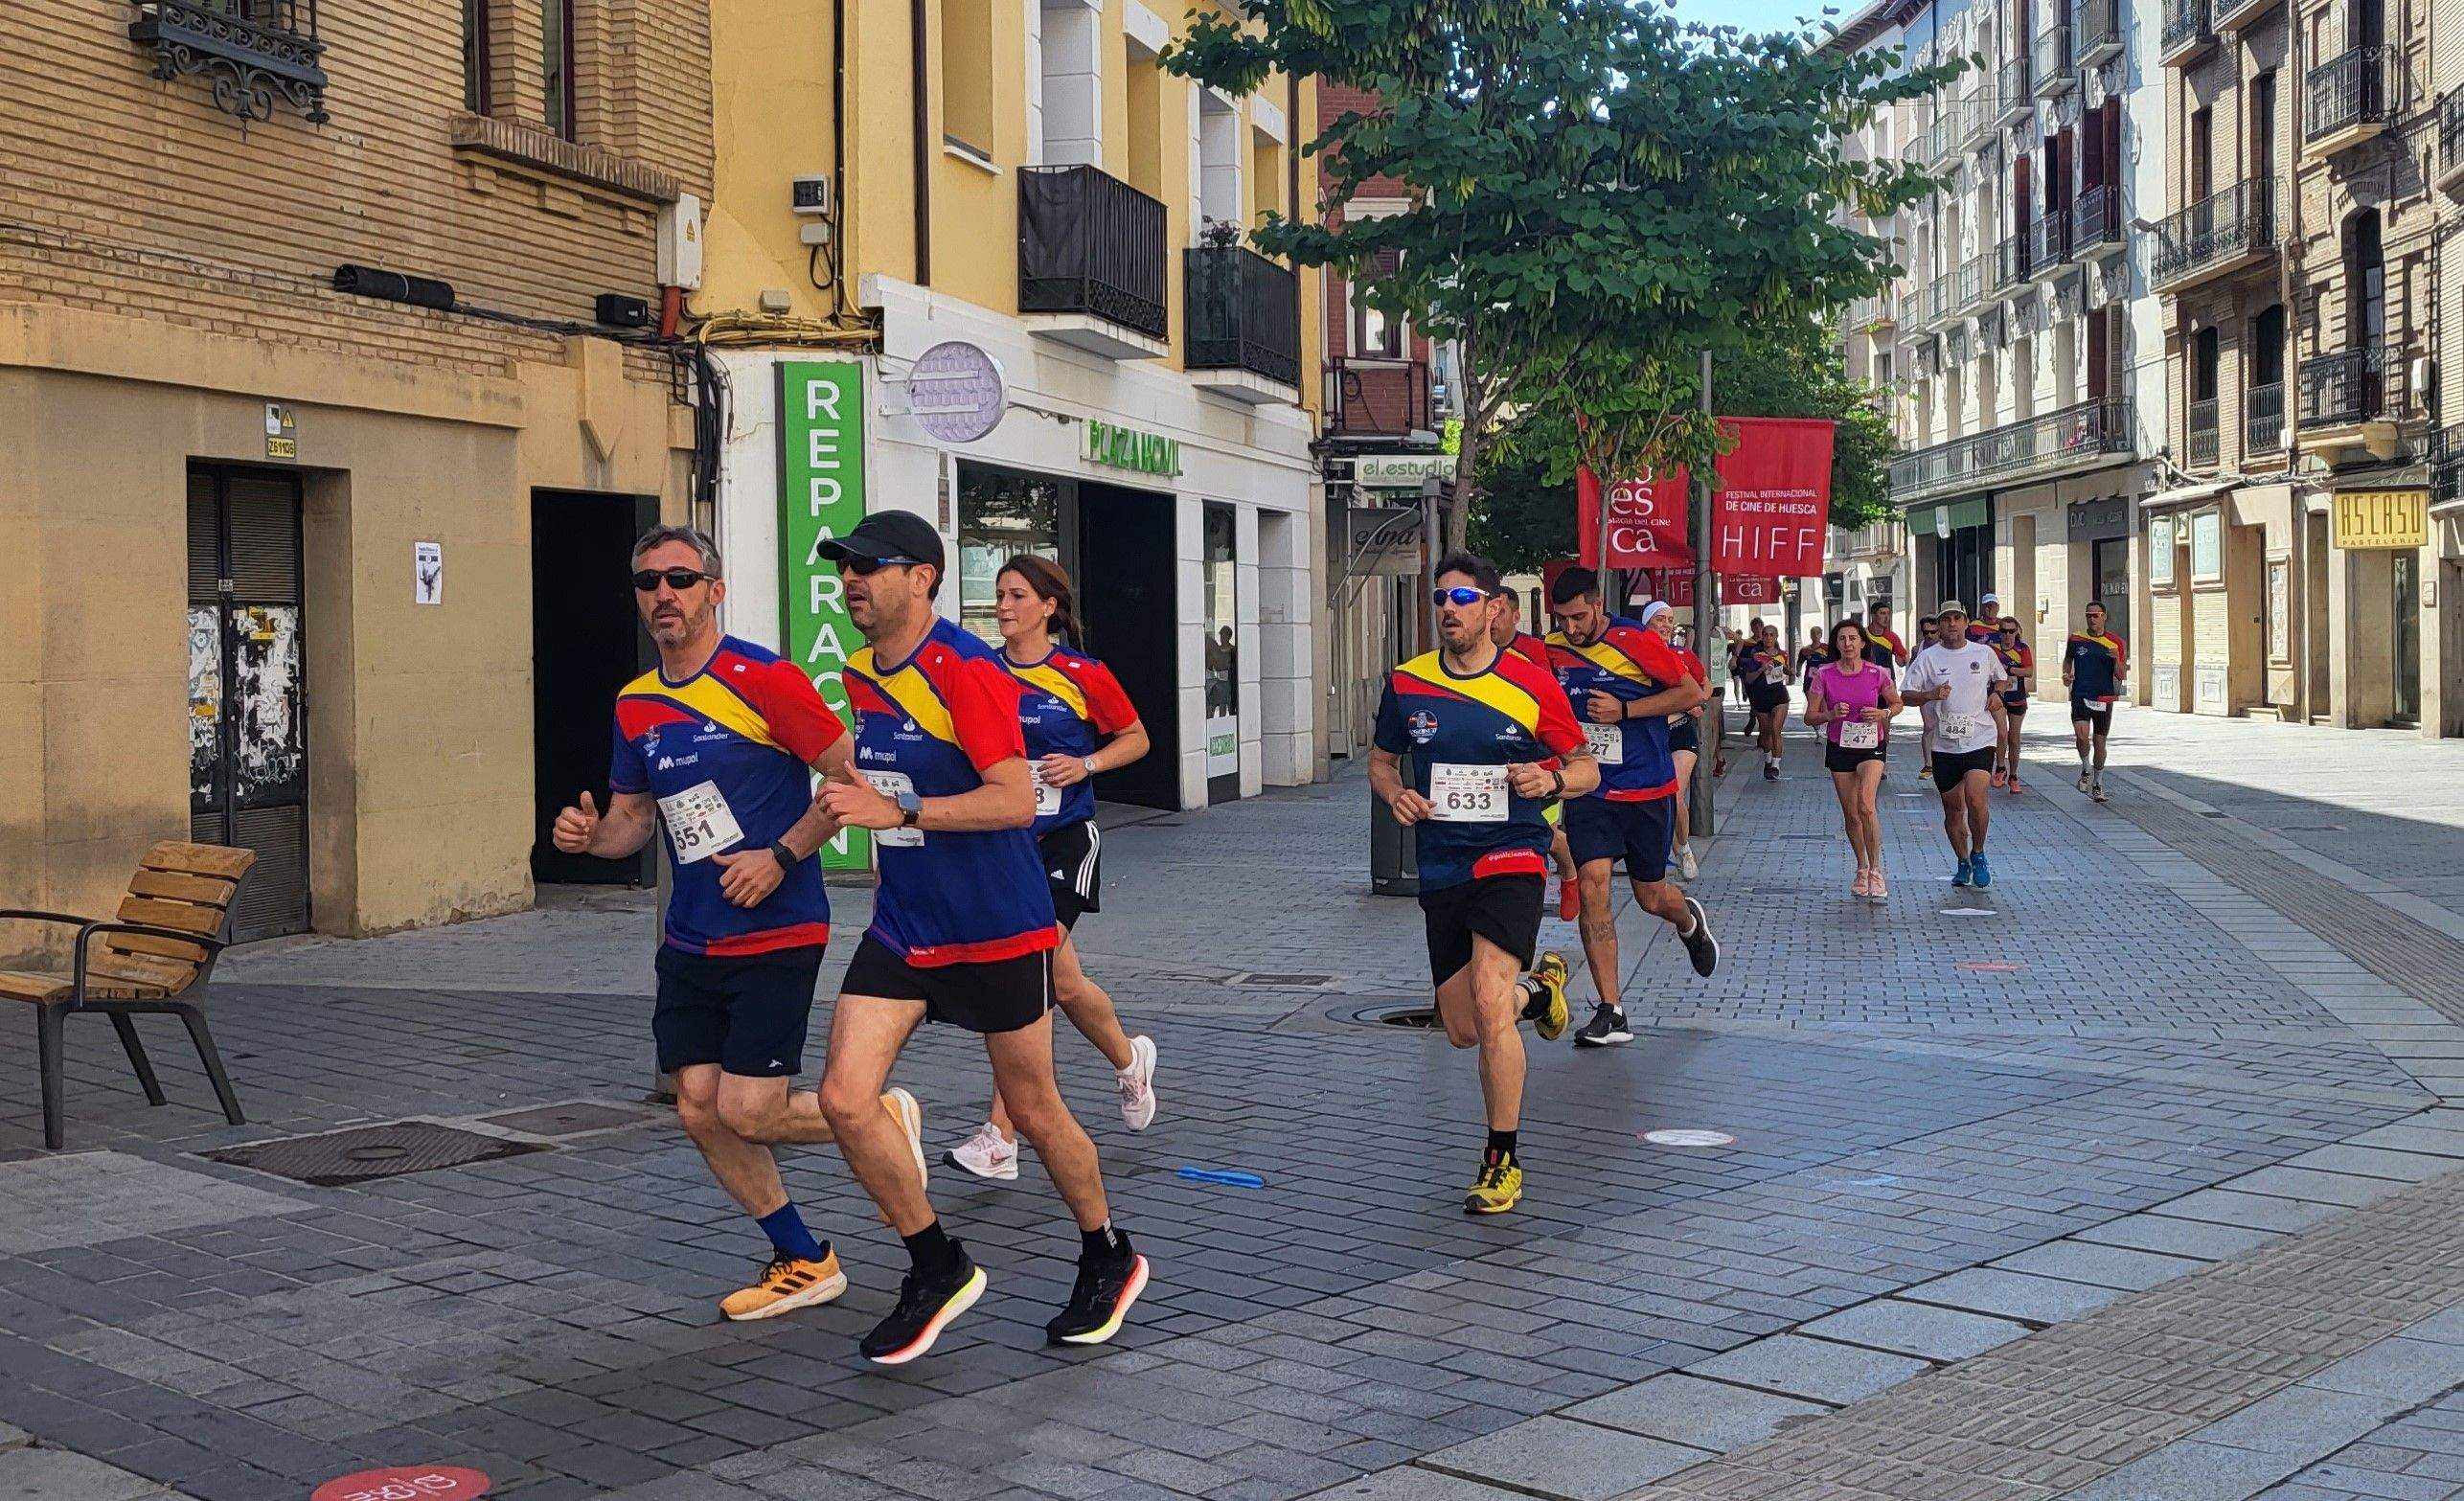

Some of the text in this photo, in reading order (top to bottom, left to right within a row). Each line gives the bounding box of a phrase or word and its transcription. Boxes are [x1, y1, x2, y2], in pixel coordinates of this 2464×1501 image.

[1726, 489, 1817, 499] FESTIVAL INTERNACIONAL
[1726, 501, 1817, 514] DE CINE DE HUESCA
[2340, 493, 2420, 535] ASCASO
[1612, 528, 1658, 553] ca
[1723, 525, 1816, 561] HIFF
[694, 733, 729, 742] Santander
[675, 752, 698, 766] mupol
[1448, 792, 1492, 810] 633
[674, 819, 715, 850] 551
